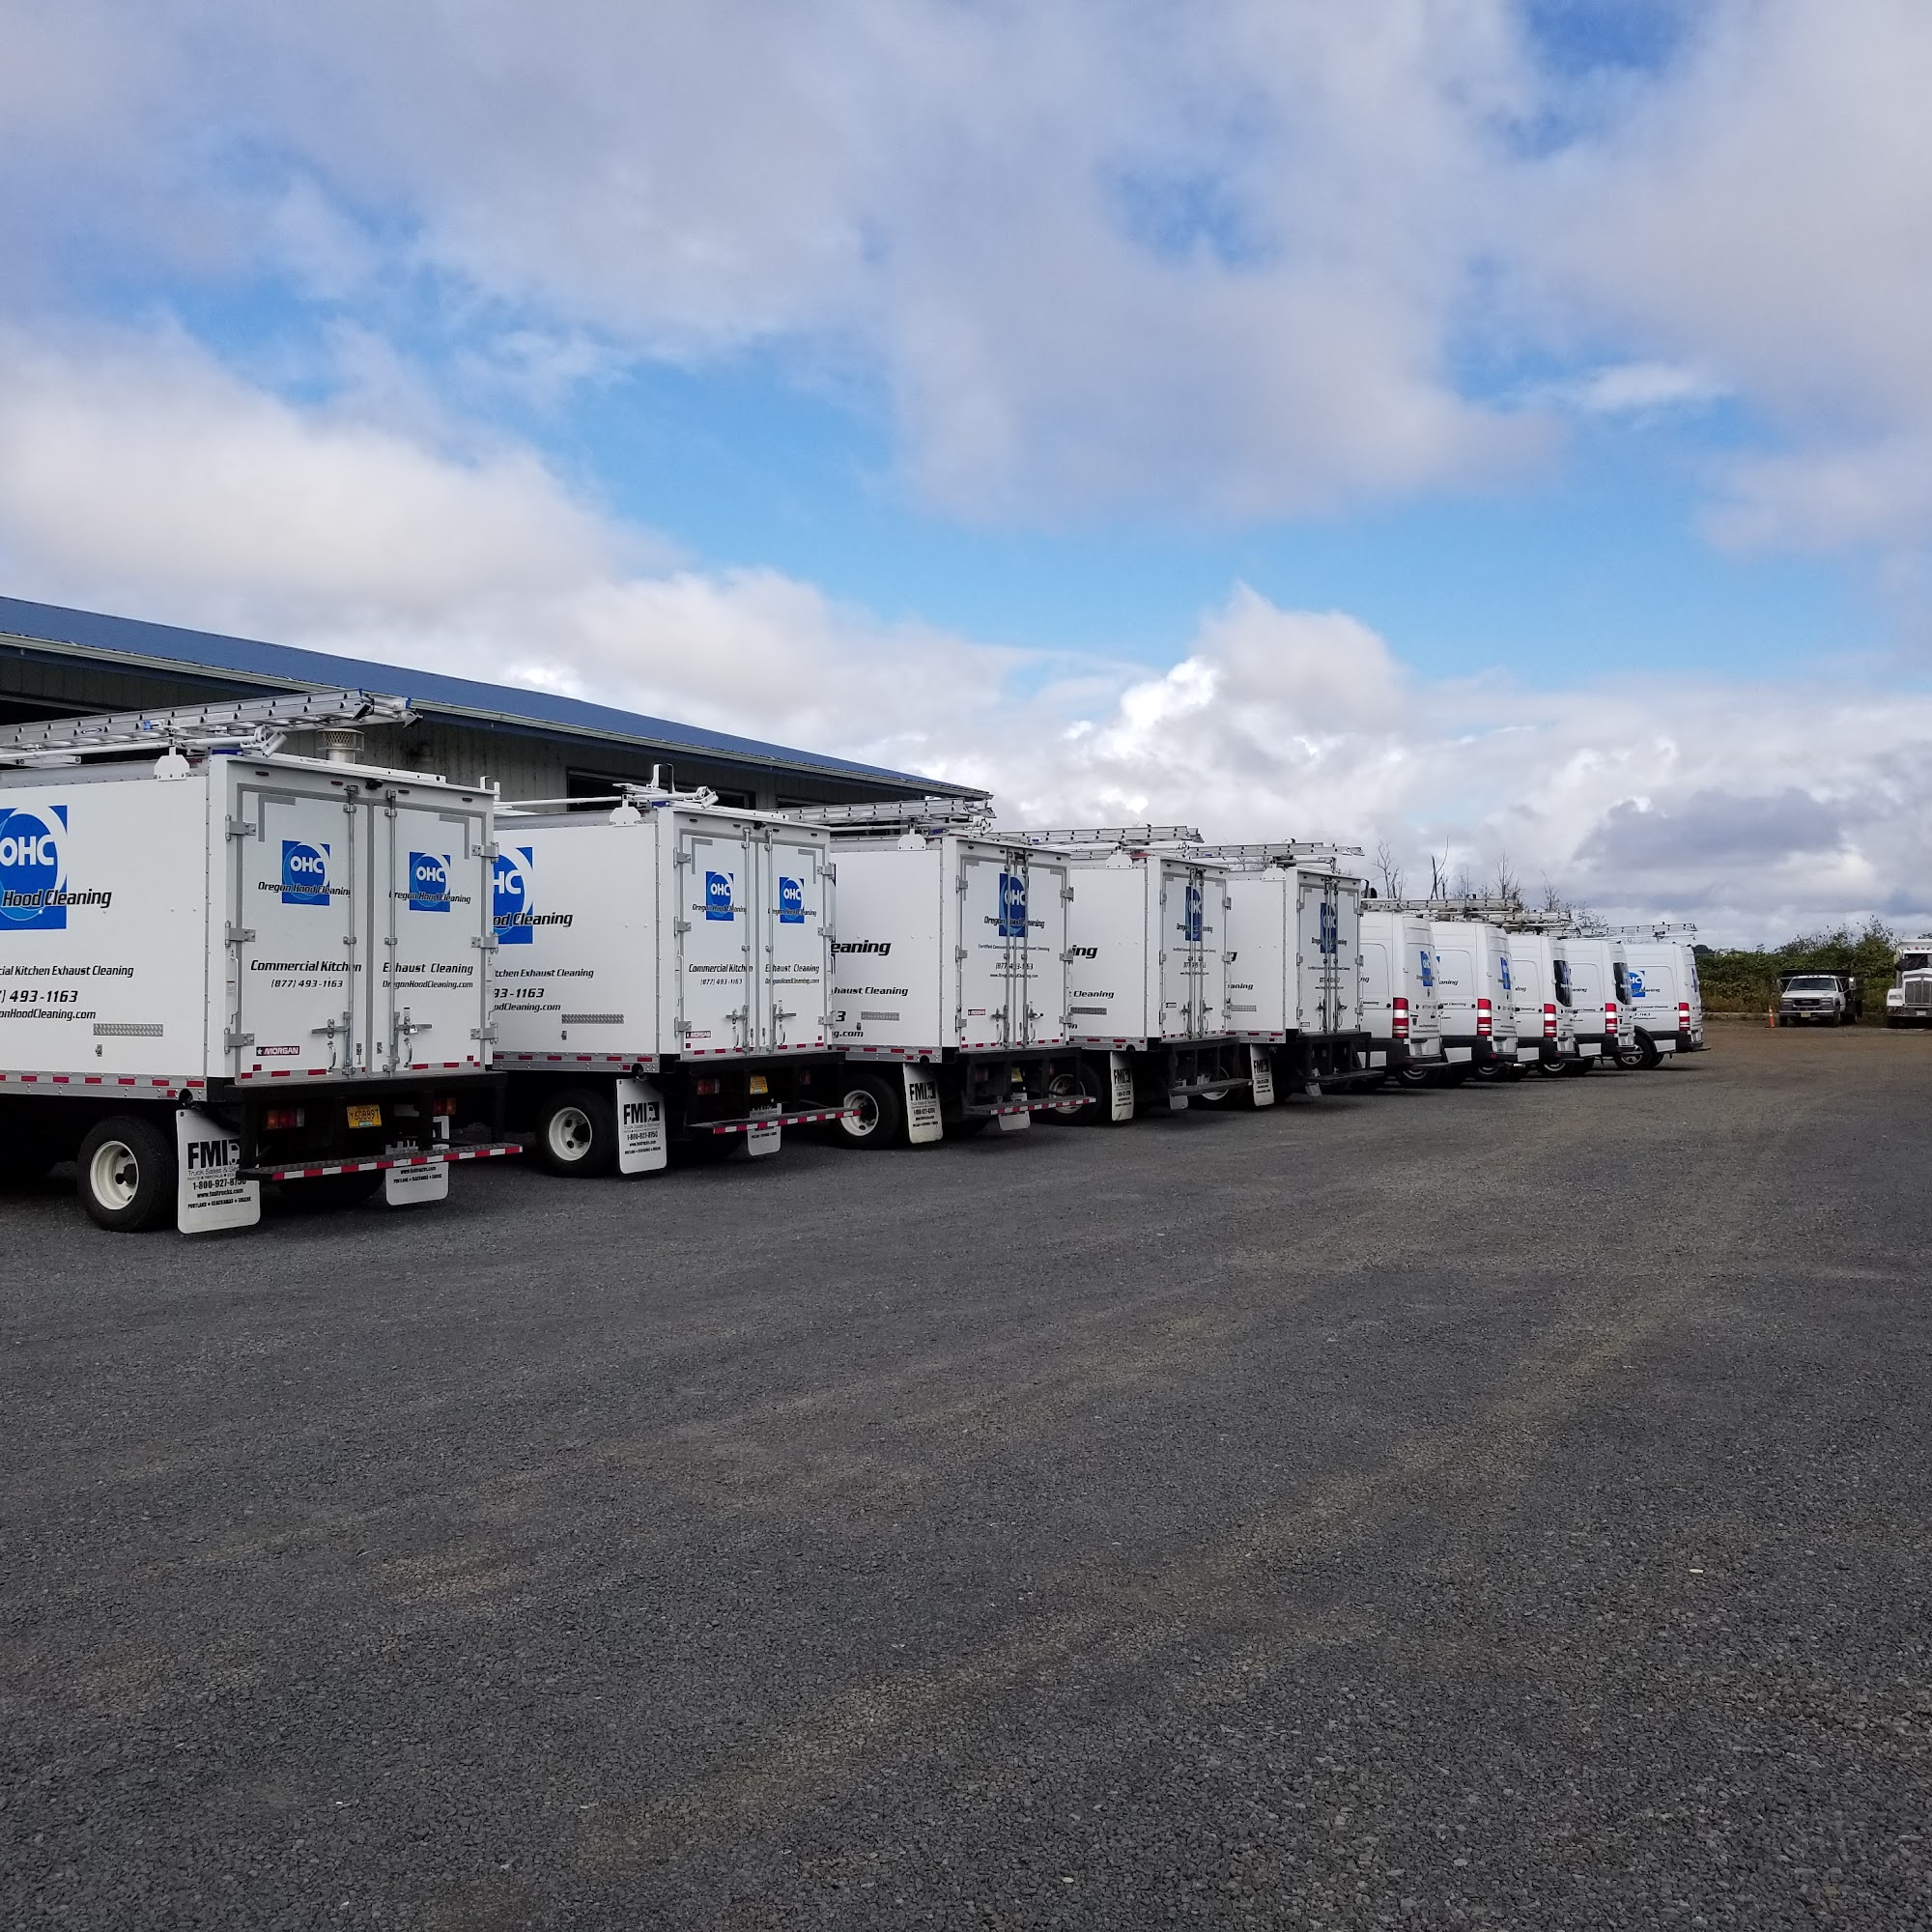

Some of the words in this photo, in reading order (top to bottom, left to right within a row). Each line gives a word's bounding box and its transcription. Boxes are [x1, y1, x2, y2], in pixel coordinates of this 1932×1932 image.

[0, 834, 54, 867] OHC
[291, 856, 324, 873] OHC
[416, 867, 445, 883] OHC
[258, 881, 292, 894] Oregon
[293, 883, 318, 894] Hood
[711, 883, 731, 895] OHC
[2, 889, 43, 907] Hood
[44, 888, 112, 908] Cleaning
[418, 892, 440, 901] Hood
[440, 894, 471, 904] Cleaning
[783, 888, 801, 900] OHC
[692, 903, 712, 913] Oregon
[513, 912, 574, 927] Cleaning
[831, 940, 892, 955] eaning
[14, 965, 50, 976] Kitchen
[51, 965, 91, 976] Exhaust
[92, 965, 134, 978] Cleaning
[250, 959, 320, 972] Commercial
[320, 961, 362, 973] Kitchn
[383, 962, 427, 973] Ehaust
[430, 963, 474, 977] Cleaning
[688, 963, 728, 973] Commercial
[728, 964, 753, 973] Kitchn
[765, 963, 792, 973] Ehaust
[793, 963, 820, 975] Cleaning
[495, 969, 519, 978] tchen
[520, 969, 555, 978] Exhaust
[556, 968, 595, 979] Cleaning
[270, 979, 297, 988] (877)
[298, 979, 344, 988] 493-1163
[765, 978, 820, 986] OrgonHoodCleaning.com
[865, 986, 909, 996] Cleaning
[1073, 990, 1115, 999] Cleaning
[832, 1030, 864, 1038] g.com
[264, 1046, 299, 1055] MORGAN
[624, 1102, 647, 1124] FMI
[187, 1140, 229, 1169] FMI
